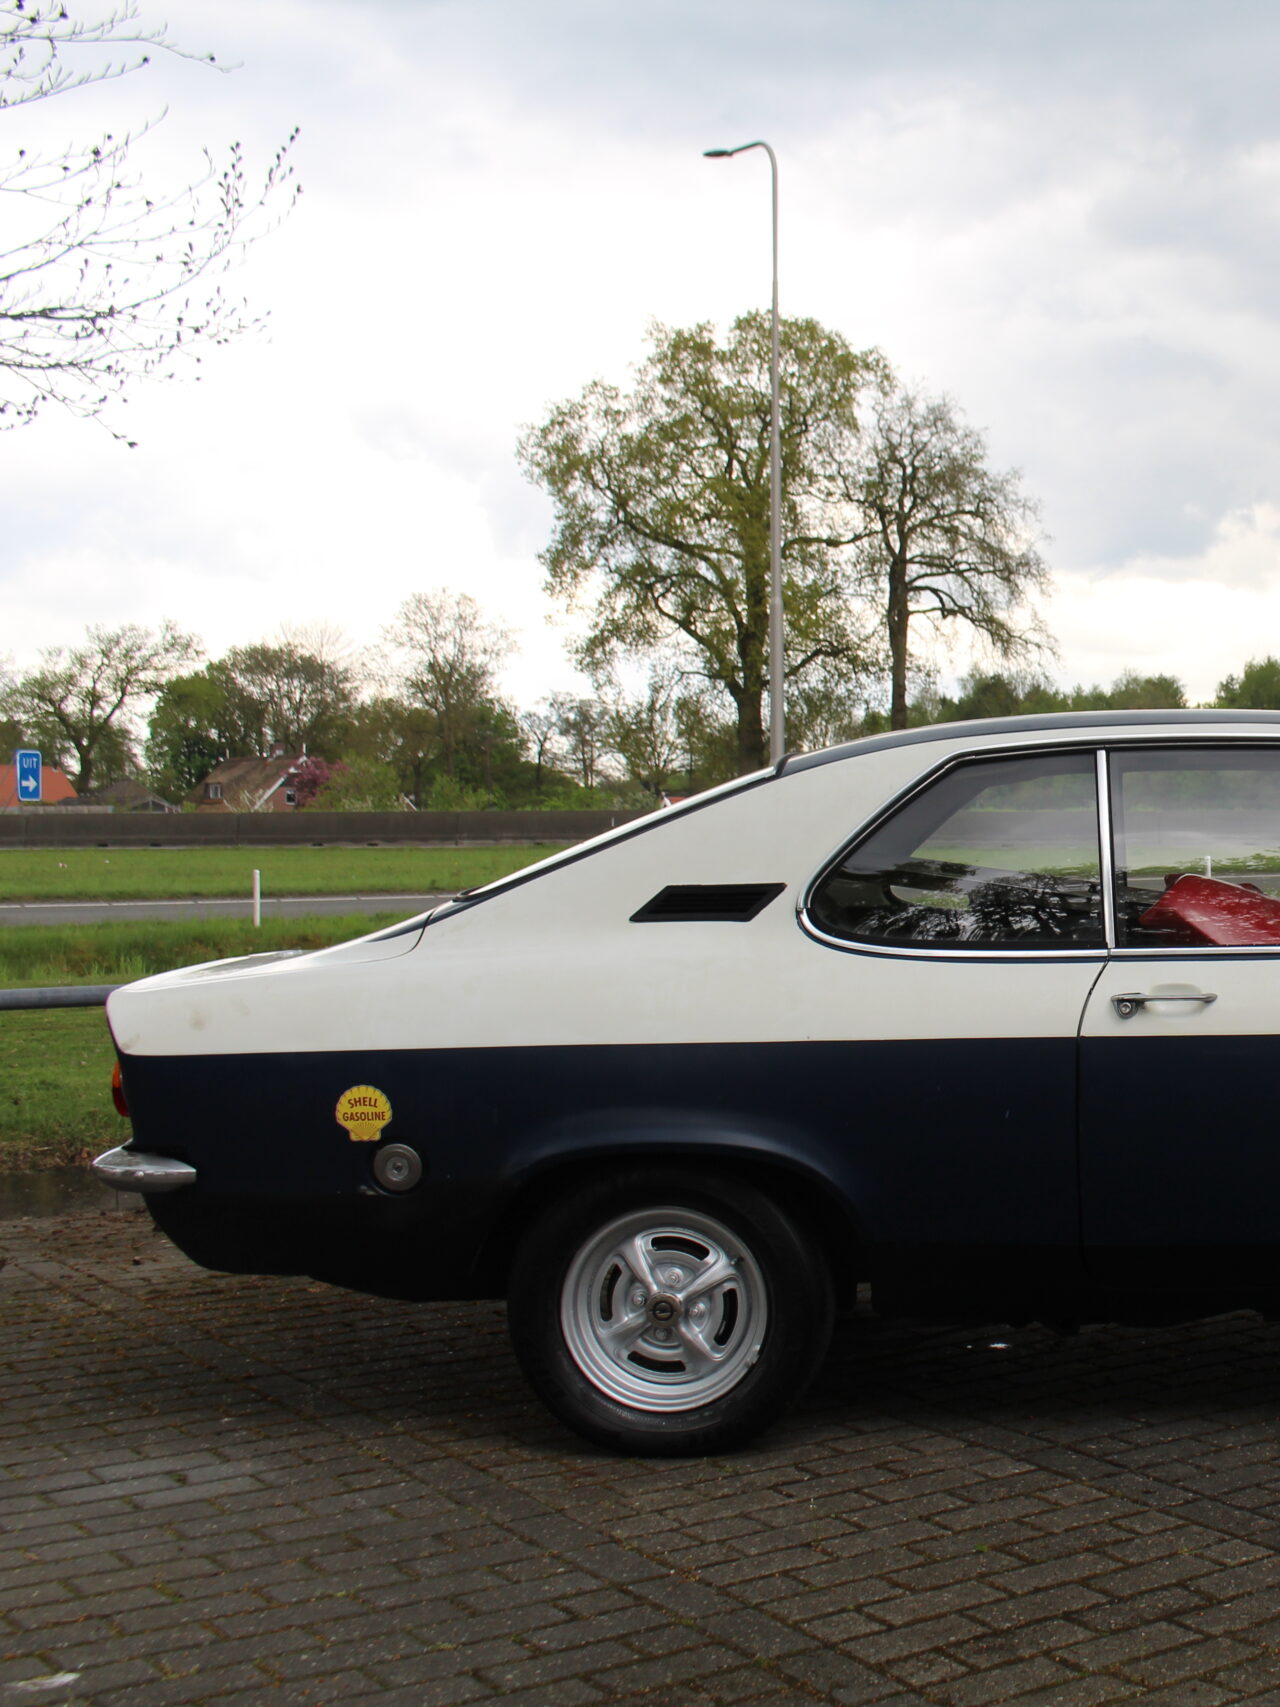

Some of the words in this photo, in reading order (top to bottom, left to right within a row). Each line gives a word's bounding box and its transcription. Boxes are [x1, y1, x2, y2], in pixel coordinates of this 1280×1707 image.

[23, 757, 38, 769] UIT
[347, 1096, 378, 1109] SHELL
[342, 1111, 386, 1122] GASOLINE
